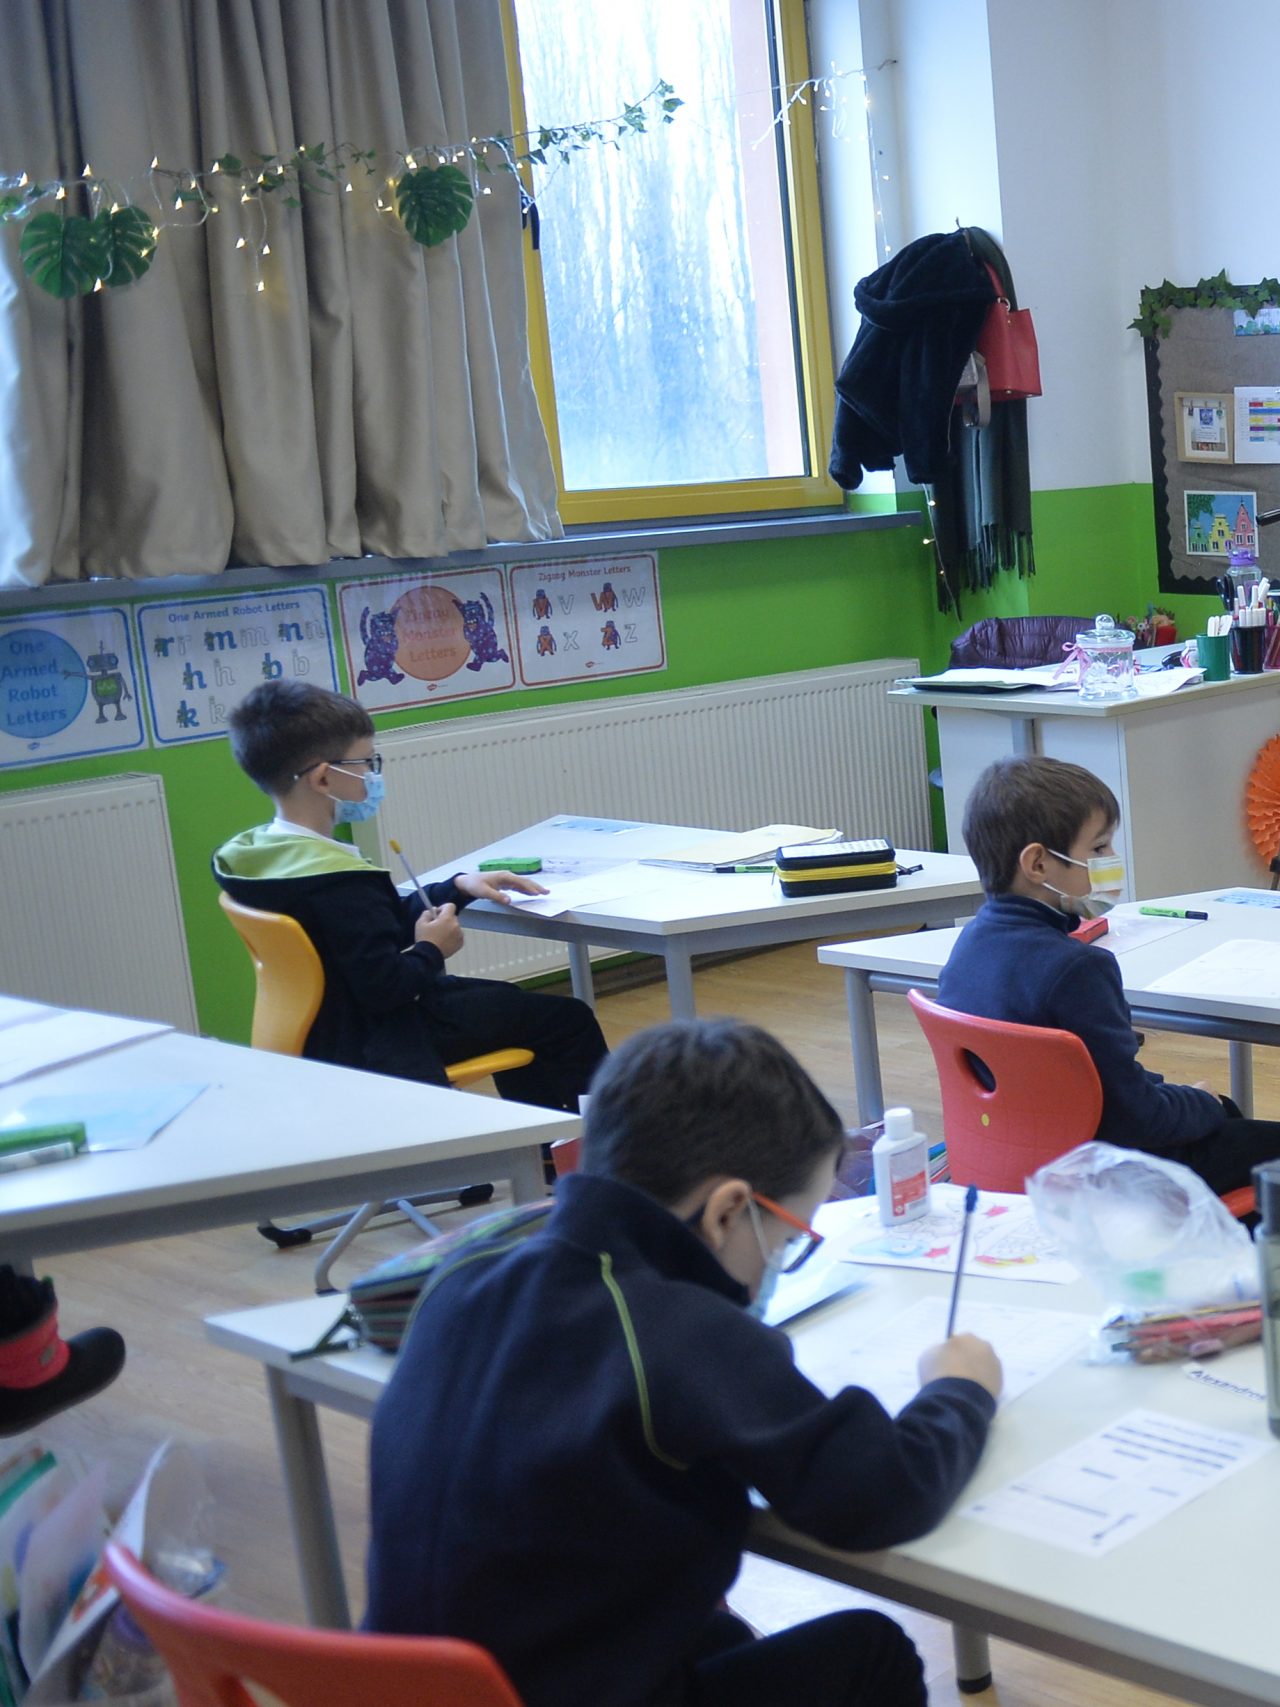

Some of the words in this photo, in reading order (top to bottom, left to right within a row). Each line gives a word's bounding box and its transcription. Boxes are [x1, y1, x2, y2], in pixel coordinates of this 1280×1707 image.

[568, 568, 601, 578] Monster
[604, 565, 631, 575] Letters
[169, 613, 189, 623] One
[193, 609, 229, 620] Armed
[233, 605, 263, 616] Robot
[266, 601, 301, 612] Letters
[10, 640, 43, 655] One
[410, 647, 456, 662] Letters
[1, 659, 58, 681] Armed
[8, 685, 58, 702] Robot
[7, 708, 67, 726] Letters
